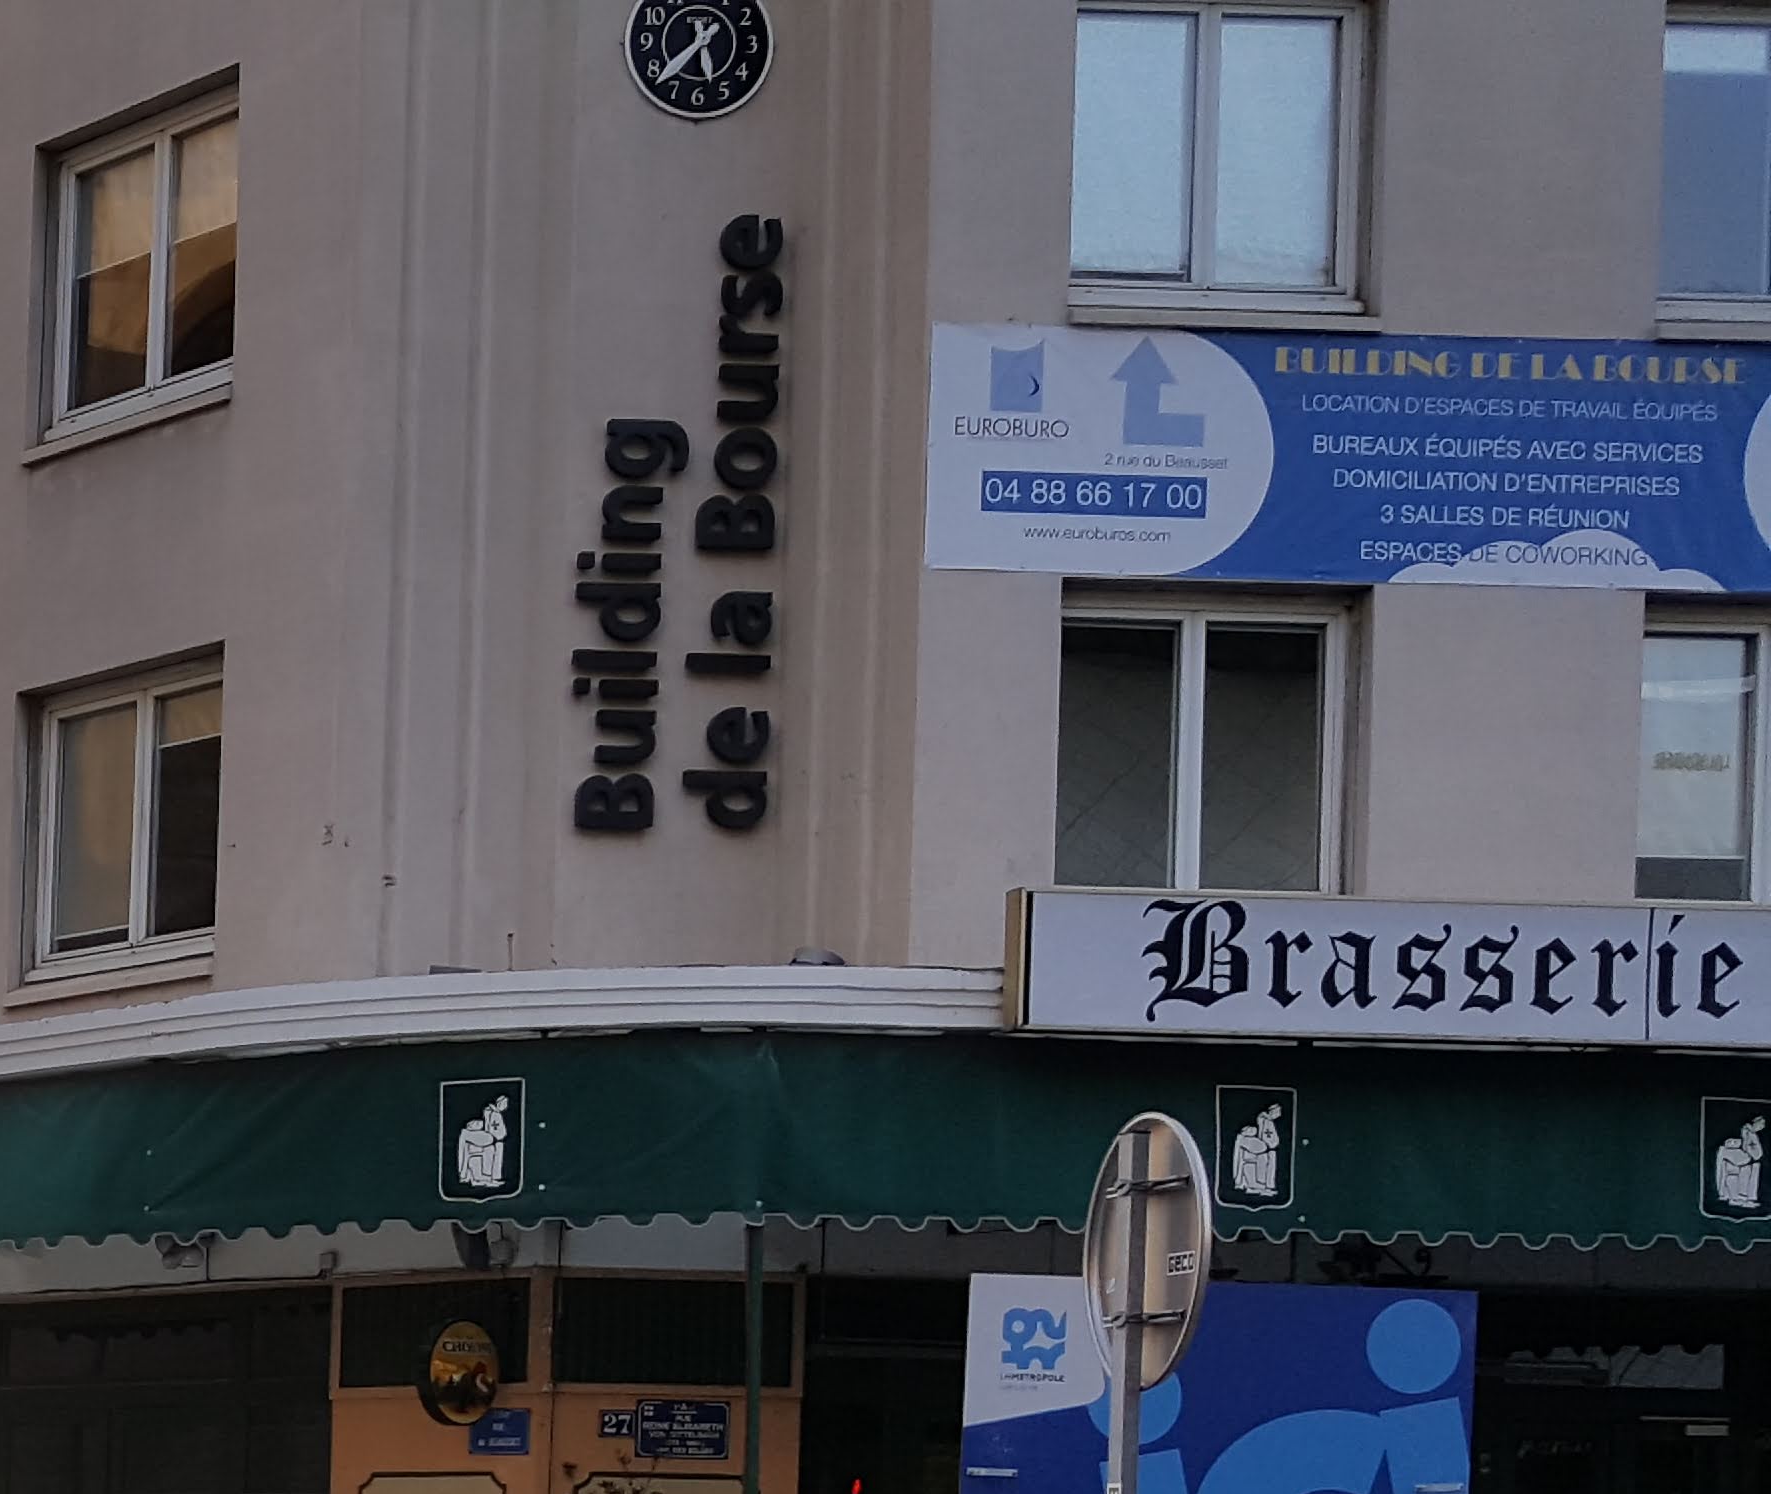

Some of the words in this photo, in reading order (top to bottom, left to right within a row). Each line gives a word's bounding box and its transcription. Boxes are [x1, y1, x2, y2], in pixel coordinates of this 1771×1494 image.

[643, 6, 666, 26] 10
[739, 7, 752, 26] 2
[640, 32, 654, 51] 9
[745, 34, 758, 54] 3
[646, 59, 661, 78] 8
[734, 61, 749, 81] 4
[668, 80, 680, 100] 7
[690, 86, 704, 106] 6
[718, 80, 730, 100] 5
[1275, 347, 1460, 378] BUILDING
[1471, 352, 1523, 380] DE
[1531, 354, 1583, 381] LA
[1592, 354, 1748, 385] BOURSE
[695, 212, 784, 552] Bourse
[1301, 394, 1399, 414] LOCATION
[1404, 396, 1514, 417] D'ESPACES
[1519, 400, 1546, 418] DE
[1550, 400, 1628, 420] TRAVAIL
[954, 415, 1070, 439] EUROBURO
[1104, 453, 1114, 466] 2
[1115, 455, 1139, 468] rue
[1142, 453, 1162, 468] du
[1312, 434, 1419, 457] BUREAUX
[1424, 433, 1522, 460] ÉQUIPÉS
[1526, 440, 1587, 461] AVEC
[1592, 442, 1704, 464] SERVICES
[984, 477, 1021, 504] 04
[1029, 478, 1067, 505] 88
[1075, 480, 1112, 507] 66
[1122, 482, 1157, 509] 17
[1165, 484, 1202, 510] 00
[1333, 468, 1497, 493] DOMICILIATION
[1504, 473, 1681, 497] D'ENTREPRISES
[1379, 504, 1395, 524] 3
[1400, 504, 1484, 526] SALLES
[1491, 507, 1521, 527] DE
[1527, 503, 1630, 530] RÉUNION
[1022, 524, 1171, 545] www.euroburos.com
[1360, 540, 1462, 563] ESPACES
[1468, 544, 1499, 564] DE
[1505, 543, 1648, 567] COWORKING
[572, 417, 690, 834] Building
[685, 590, 774, 674] la
[681, 704, 770, 831] de
[1141, 898, 1745, 1023] Brasserie
[603, 1413, 632, 1434] 27
